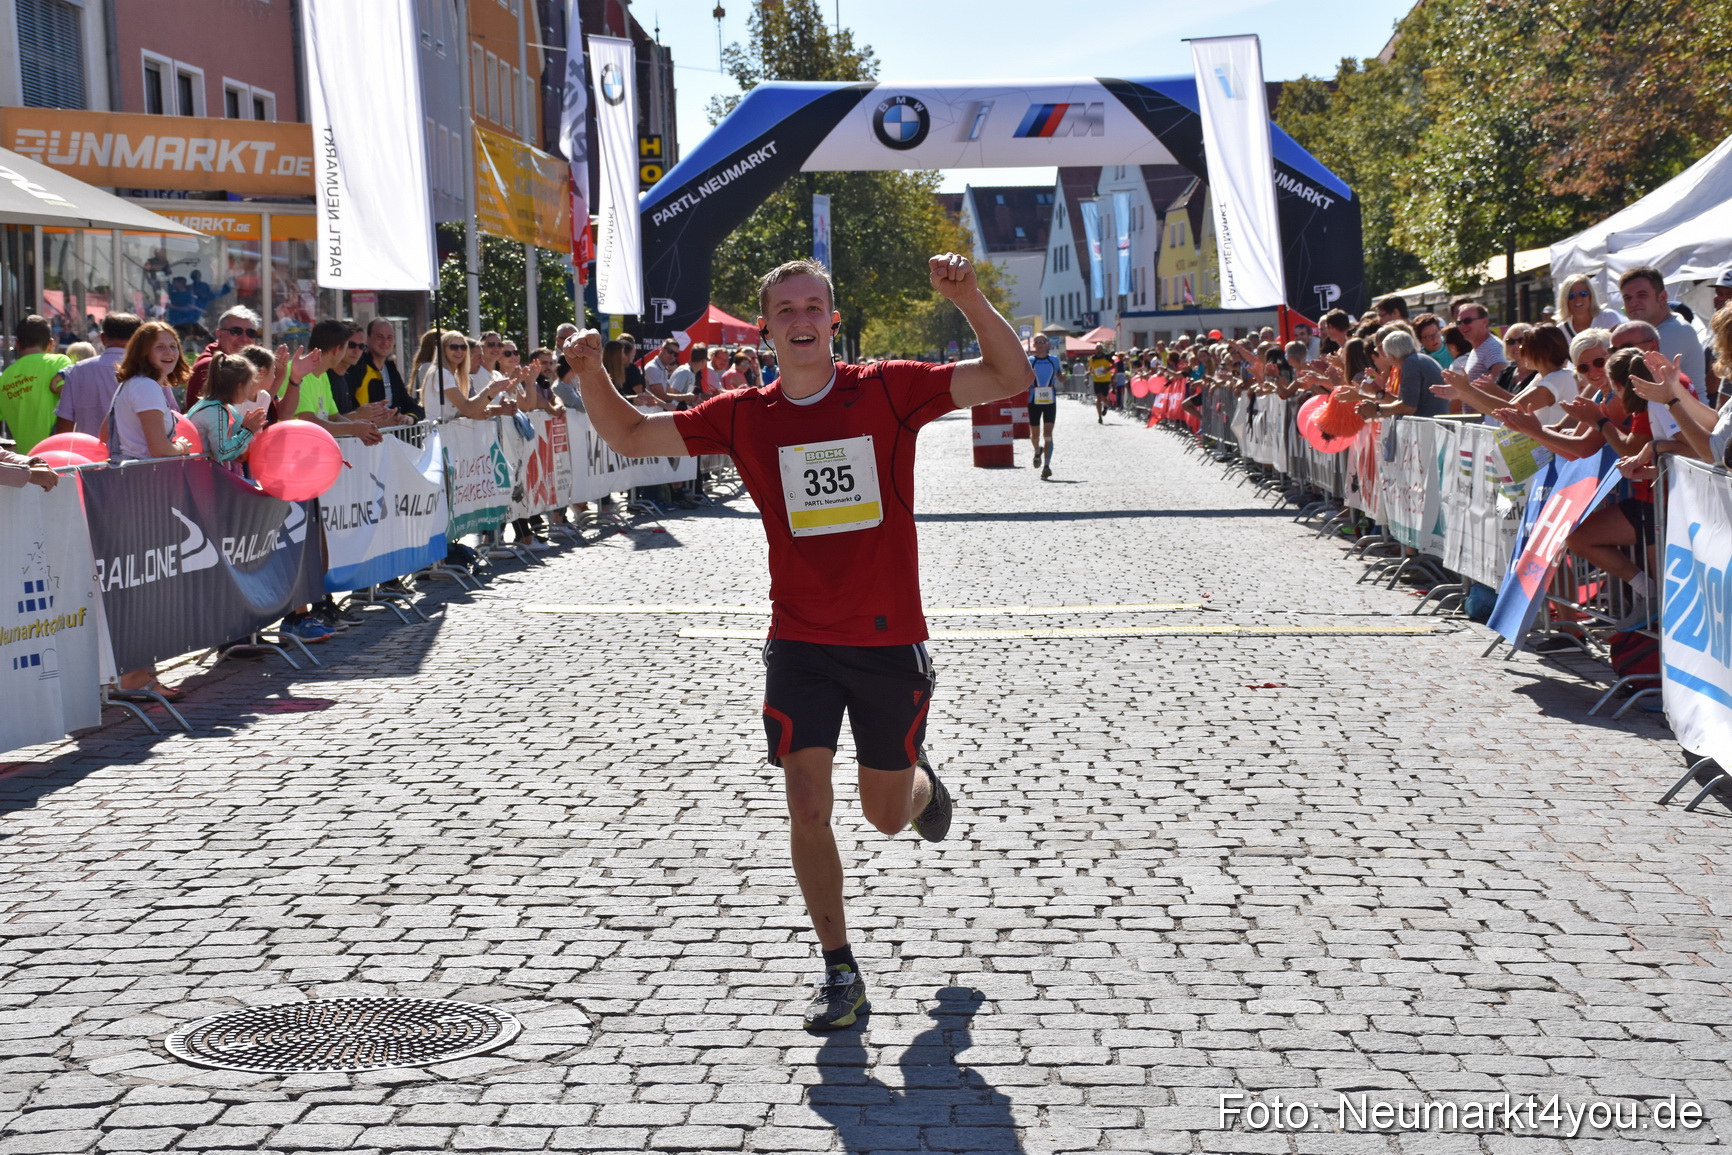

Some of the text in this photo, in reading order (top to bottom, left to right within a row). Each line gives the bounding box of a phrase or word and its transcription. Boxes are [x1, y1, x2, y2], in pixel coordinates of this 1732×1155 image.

[14, 129, 313, 177] RUNMARKT.DE
[652, 140, 778, 227] PARTL NEUMARKT
[804, 448, 846, 461] BOCK
[804, 465, 855, 496] 335
[824, 496, 852, 505] Neumarkt
